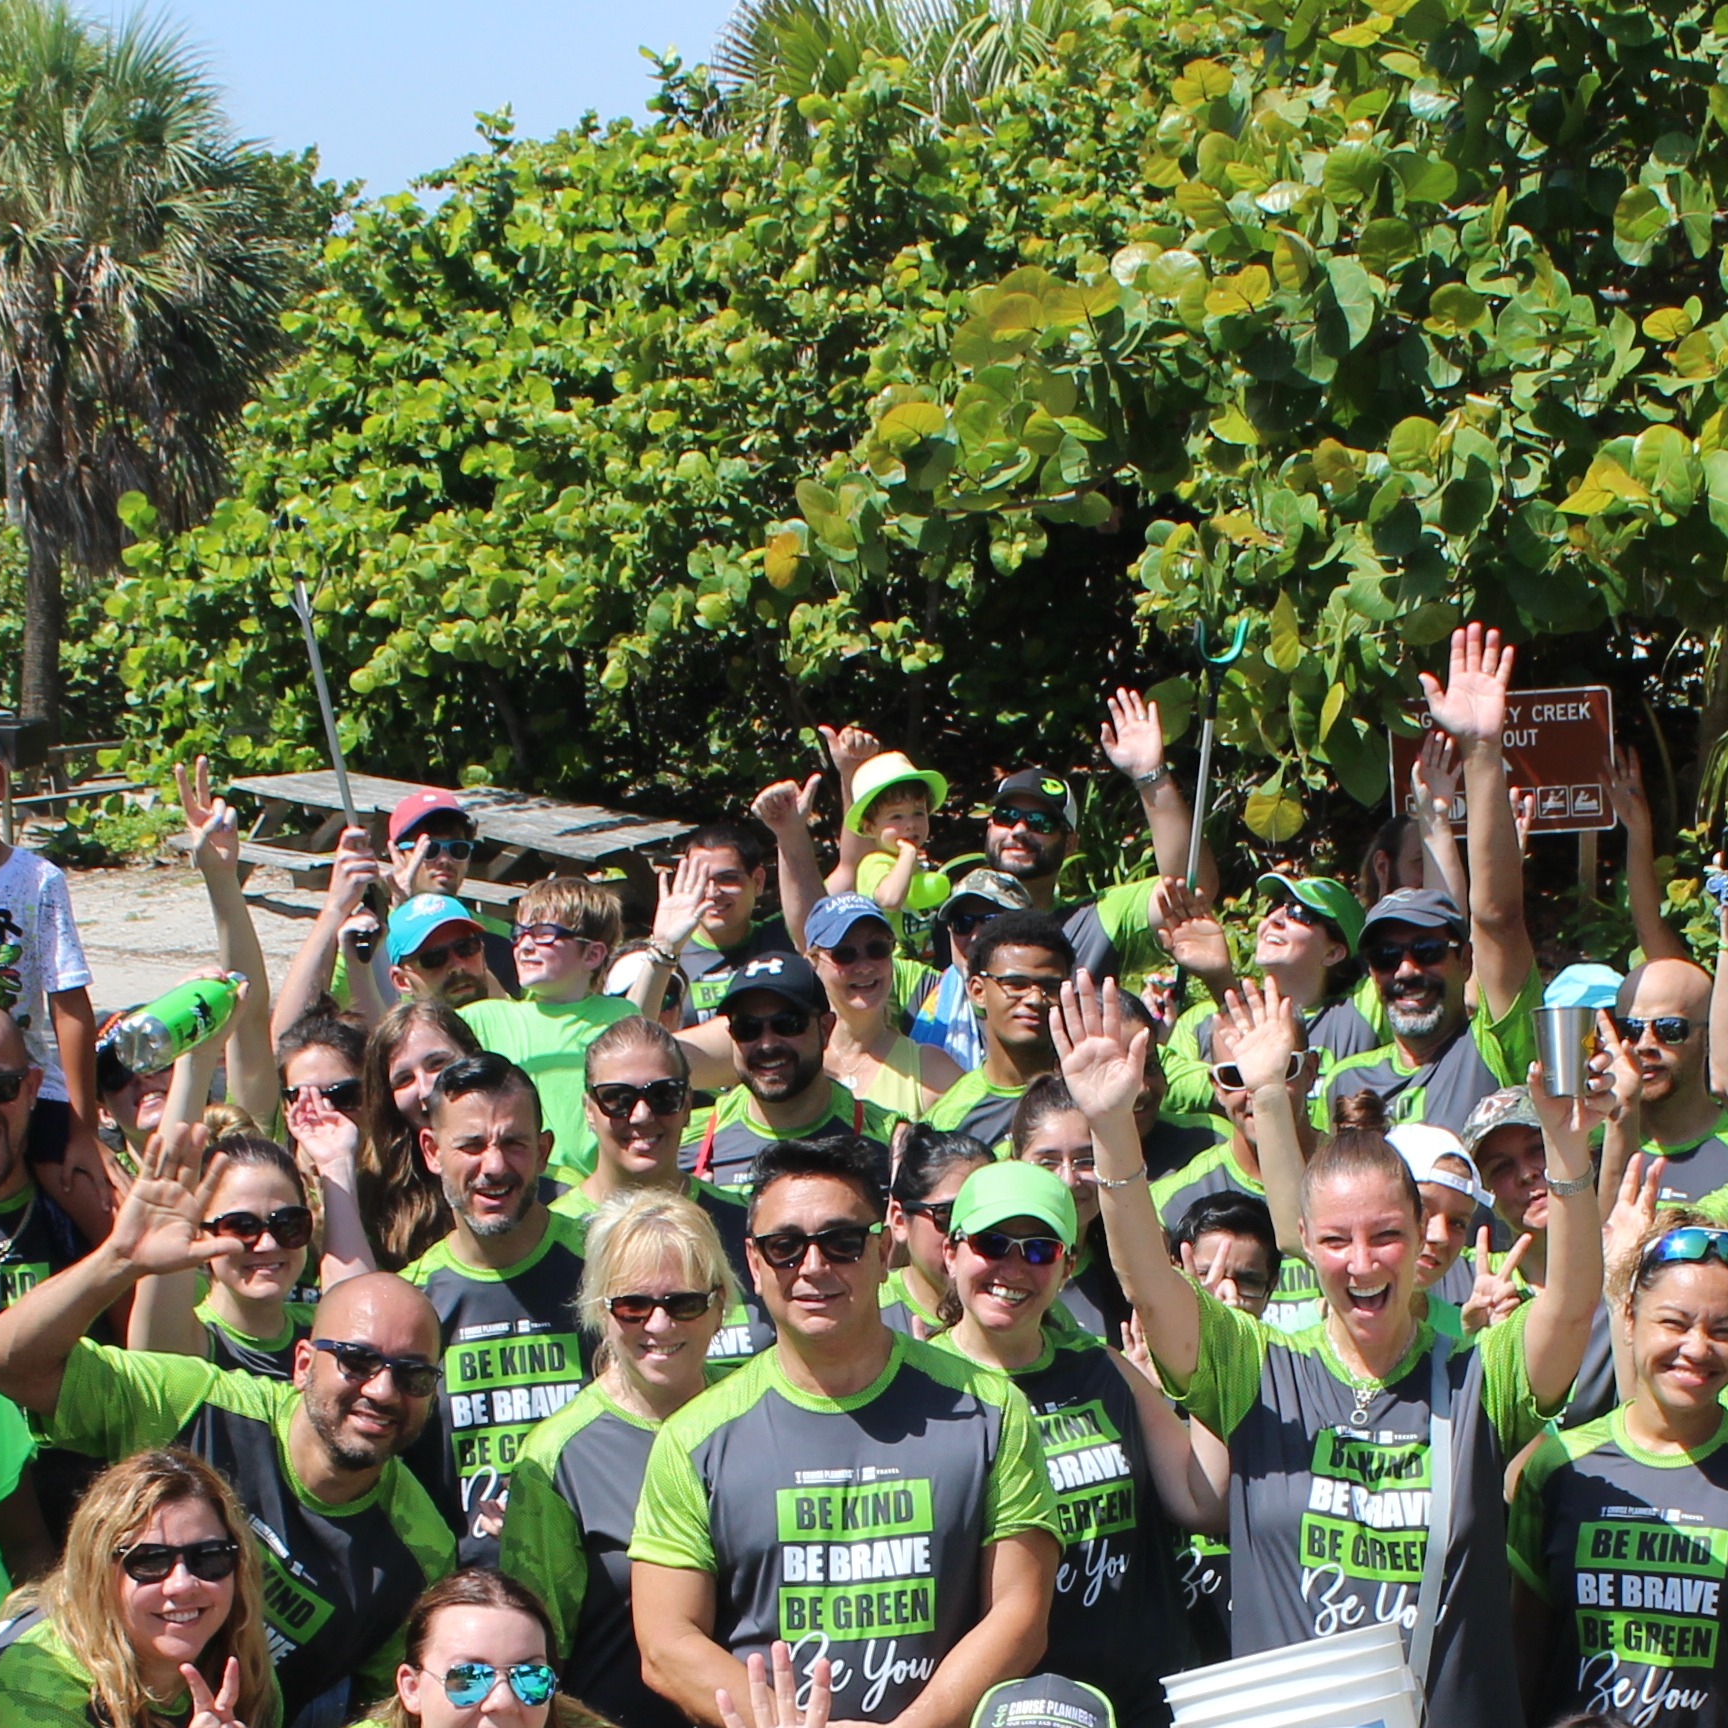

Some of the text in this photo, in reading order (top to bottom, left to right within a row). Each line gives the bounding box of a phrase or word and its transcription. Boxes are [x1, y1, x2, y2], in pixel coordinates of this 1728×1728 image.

[1532, 702, 1591, 722] CREEK
[700, 984, 721, 1002] BE
[459, 1341, 566, 1381] BE KIND
[451, 1393, 489, 1428] BE
[459, 1435, 491, 1467] BE
[1046, 1443, 1131, 1491] BRAVE
[796, 1489, 914, 1531] BE KIND
[1056, 1486, 1134, 1534] GREEN
[1308, 1477, 1351, 1516] BE
[783, 1536, 931, 1582] BE BRAVE
[1307, 1523, 1344, 1563] BE
[1591, 1528, 1713, 1566] BE KIND
[786, 1588, 929, 1630] BE GREEN
[1301, 1562, 1366, 1636] Be
[1577, 1573, 1720, 1616] BE BRAVE
[1582, 1616, 1713, 1658] BE GREEN
[861, 1639, 935, 1713] You
[1578, 1650, 1637, 1714] Be
[1008, 1699, 1096, 1728] CRUISE PLANNERS
